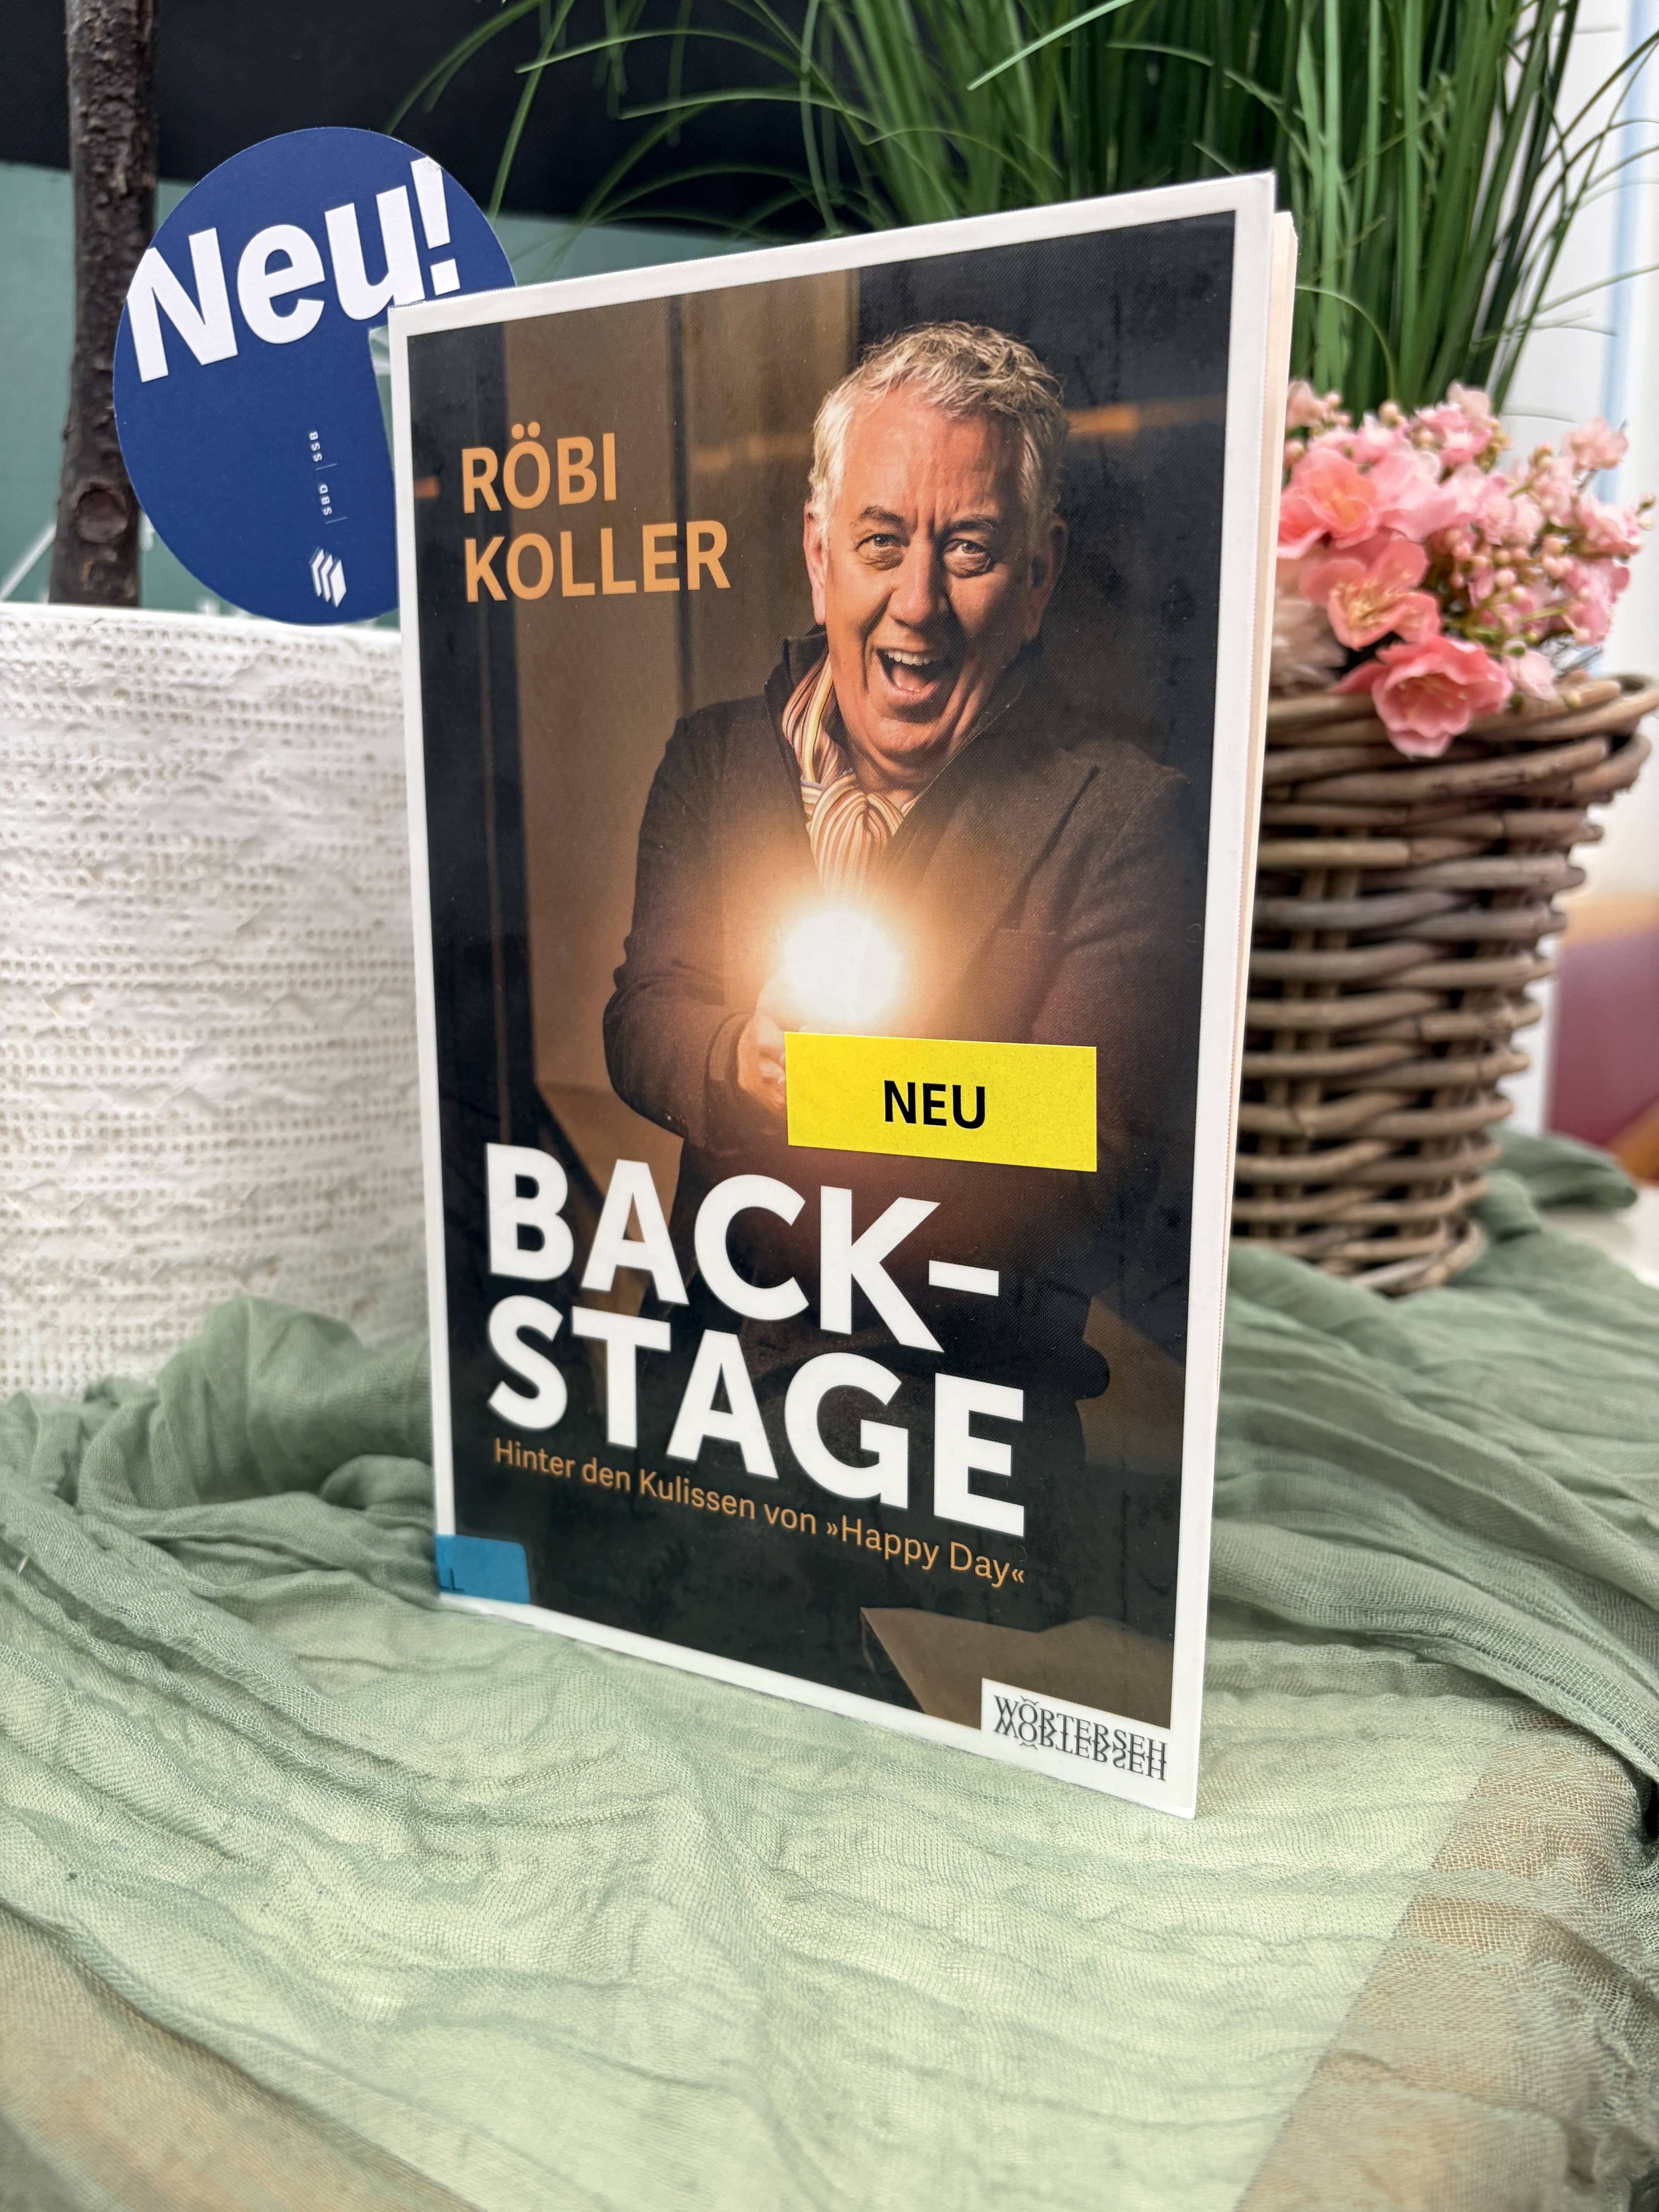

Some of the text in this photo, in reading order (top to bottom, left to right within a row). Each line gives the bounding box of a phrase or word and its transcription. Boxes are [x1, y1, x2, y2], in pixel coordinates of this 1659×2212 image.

[127, 156, 460, 382] Neu!
[462, 421, 617, 514] RÖBI
[464, 520, 731, 603] KOLLER
[883, 1080, 987, 1129] NEU
[486, 1142, 1000, 1353] BACK-
[488, 1295, 1025, 1538] STAGE
[494, 1437, 575, 1478] Hinter
[582, 1457, 631, 1492] den
[639, 1469, 755, 1520] Kulissen
[764, 1504, 816, 1534] von
[993, 1695, 1168, 1781] WÖRTERSEH
